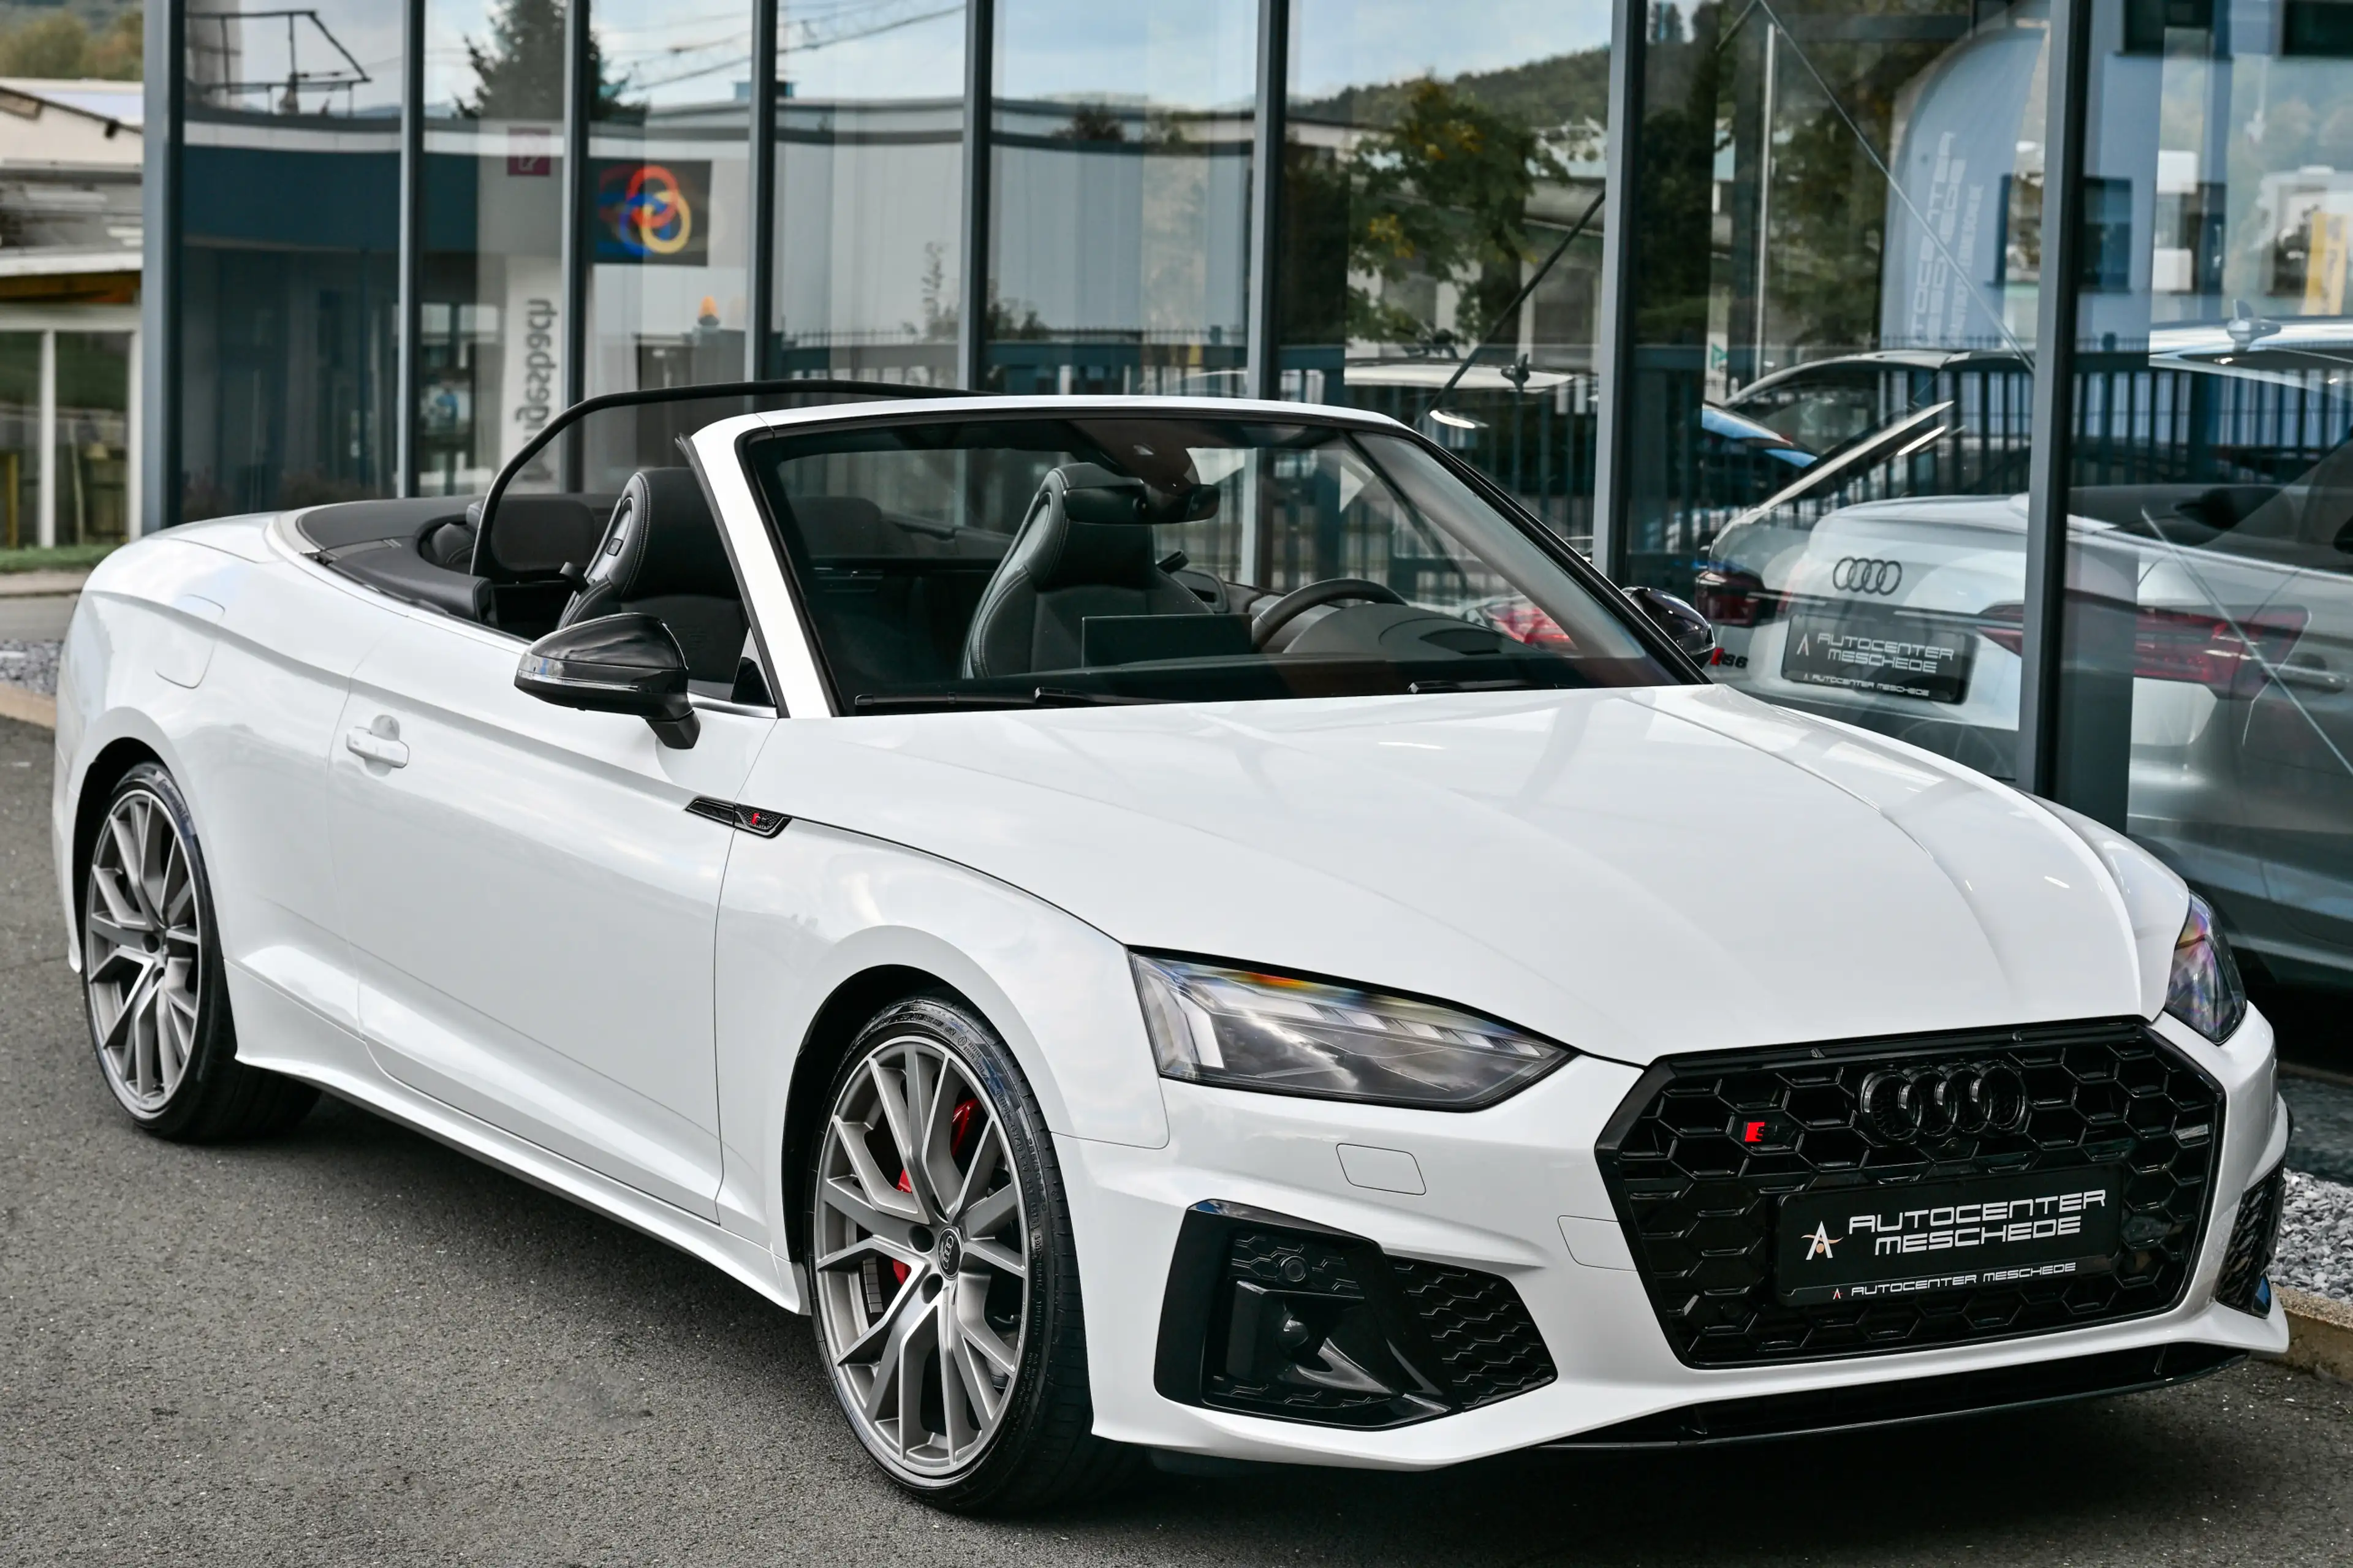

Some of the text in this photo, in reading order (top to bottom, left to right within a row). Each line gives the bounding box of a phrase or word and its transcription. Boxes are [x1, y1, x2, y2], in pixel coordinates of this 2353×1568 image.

[1817, 633, 1954, 661] AUTOCENTER
[1828, 648, 1938, 673] MESCHEDE
[1812, 674, 1930, 697] AUTOCENTER MESCHEDE
[1848, 1189, 2106, 1235] AUTOCENTER
[1875, 1215, 2082, 1256] MESCHEDE
[1851, 1262, 2077, 1297] AUTOCENTER MESCHEDE
